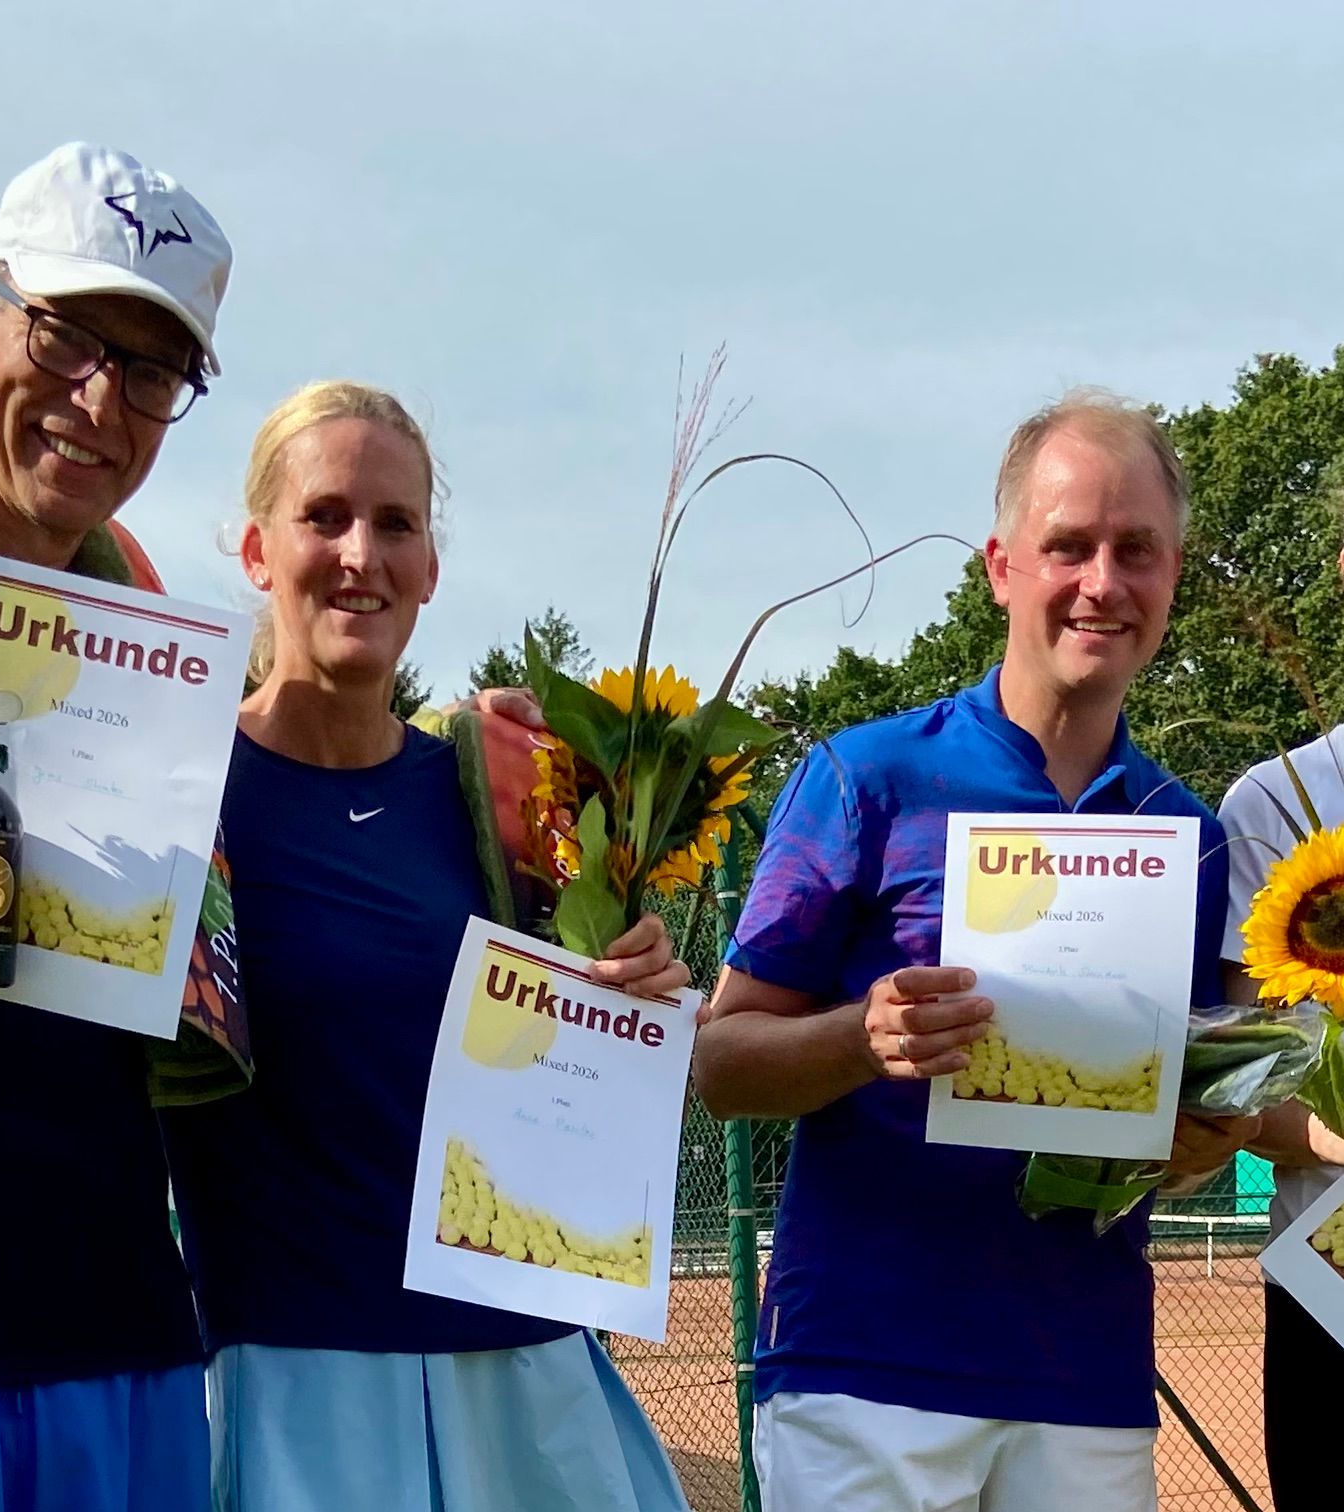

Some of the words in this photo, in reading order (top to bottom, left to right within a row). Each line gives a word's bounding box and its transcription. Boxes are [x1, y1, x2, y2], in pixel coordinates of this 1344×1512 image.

[49, 697, 93, 720] Mixed
[96, 708, 129, 728] 2026
[978, 846, 1166, 878] Urkunde
[1036, 910, 1073, 922] Mixed
[1076, 911, 1104, 922] 2026
[486, 963, 665, 1048] Urkunde
[532, 1053, 569, 1073] Mixed
[571, 1063, 599, 1081] 2026
